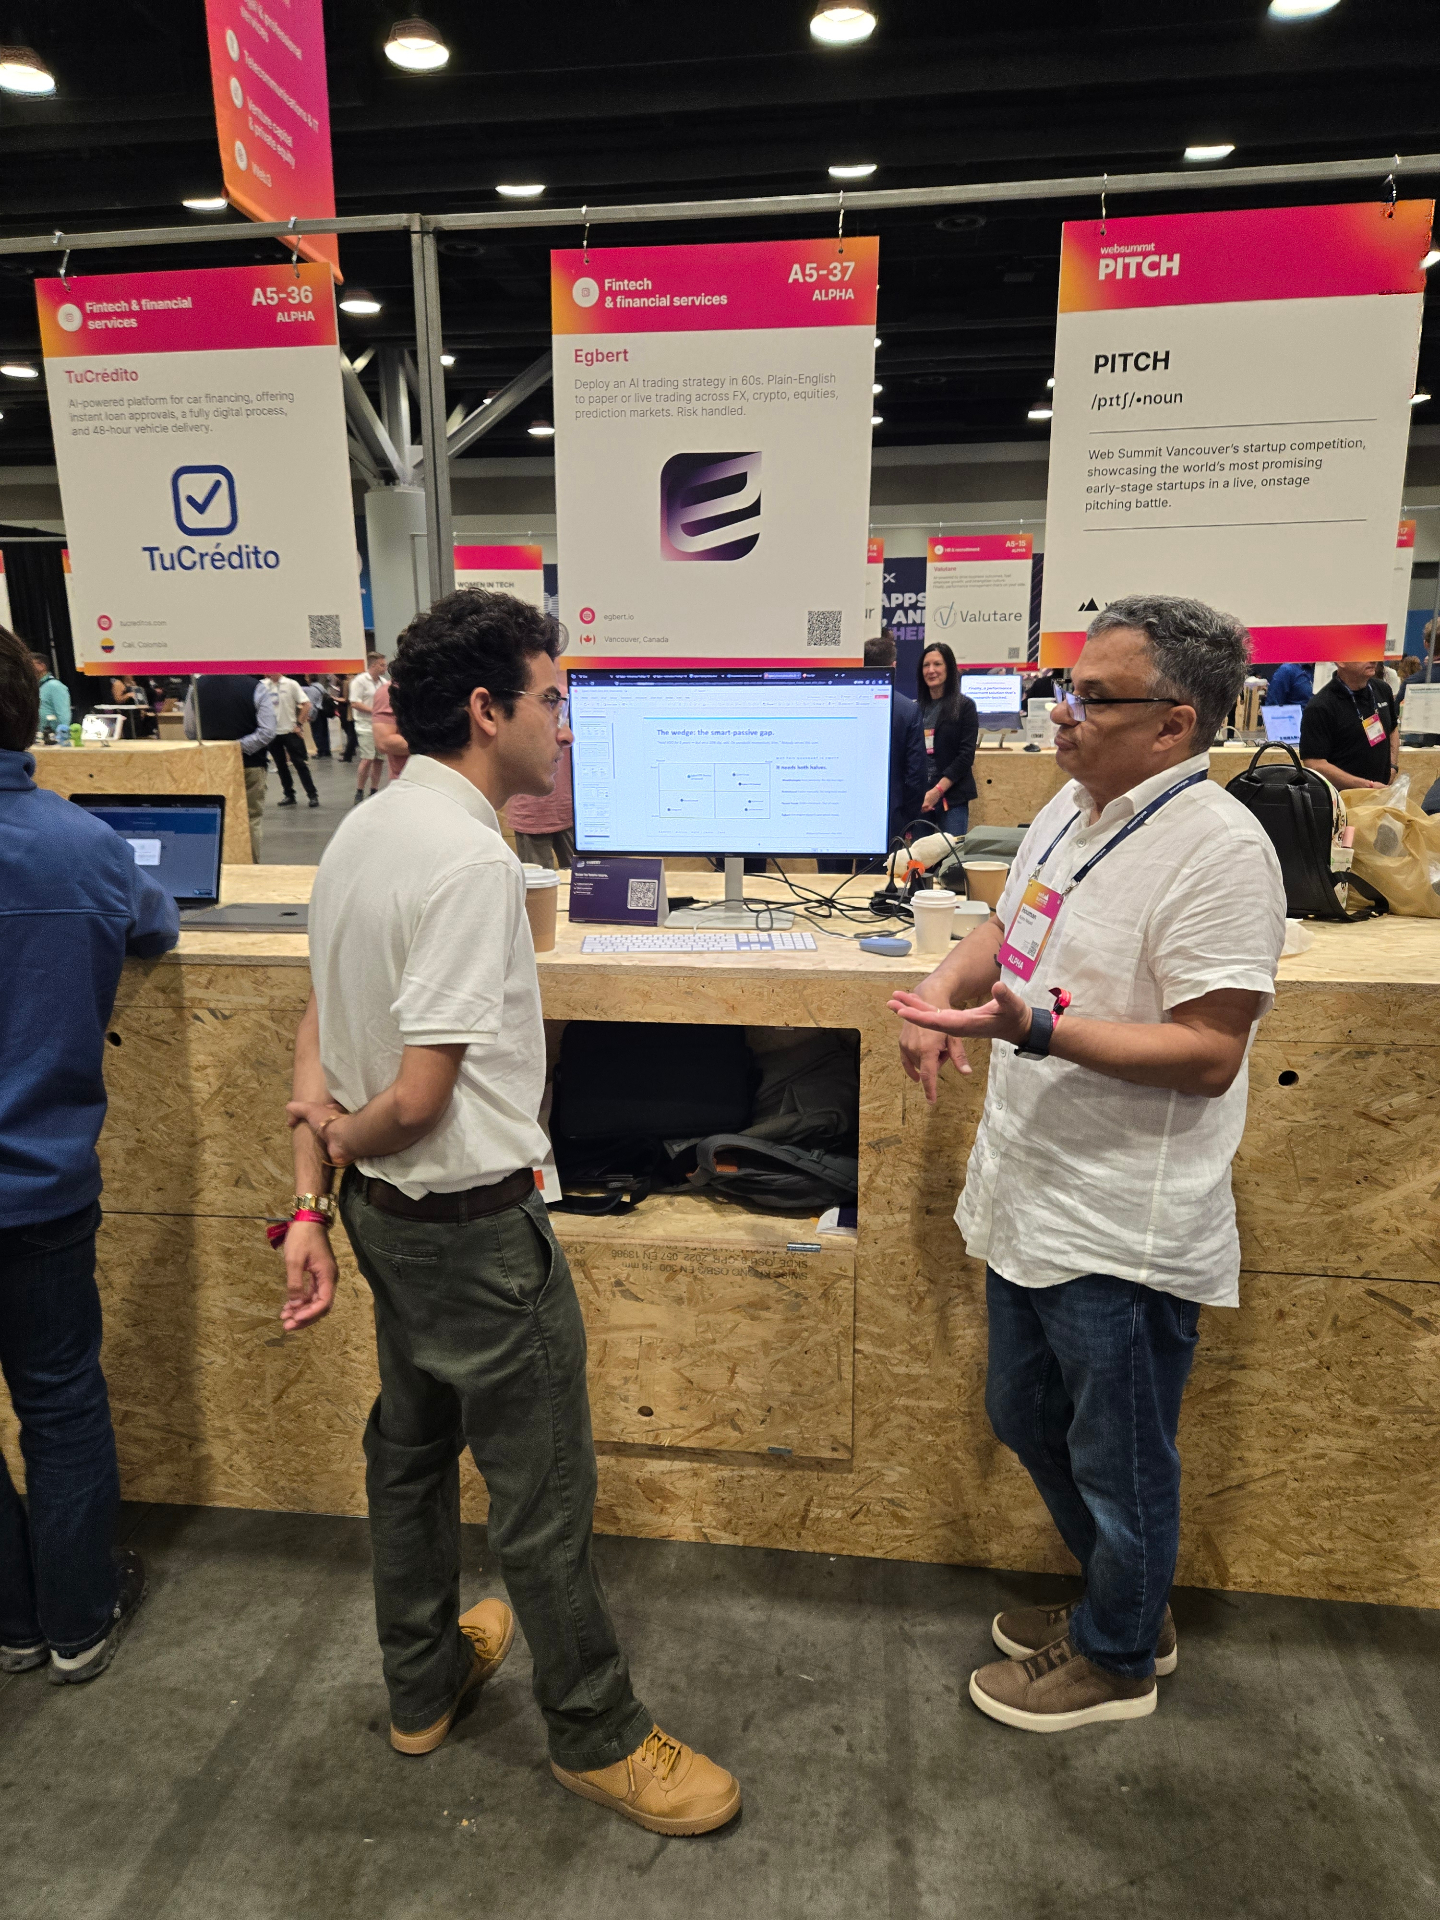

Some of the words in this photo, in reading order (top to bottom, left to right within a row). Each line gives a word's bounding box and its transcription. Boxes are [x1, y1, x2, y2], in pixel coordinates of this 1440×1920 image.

[1100, 242, 1155, 254] websummit
[788, 262, 855, 283] A5-37
[1099, 253, 1180, 280] PITCH
[604, 278, 652, 291] Fintech
[252, 286, 313, 306] A5-36
[605, 296, 614, 308] &
[616, 294, 670, 308] financial
[673, 293, 728, 306] services
[812, 289, 855, 301] ALPHA
[86, 300, 129, 314] Fintech
[131, 300, 140, 311] &
[142, 297, 192, 310] financial
[88, 317, 138, 330] services
[276, 311, 315, 323] ALPHA
[574, 349, 629, 367] Egbert
[1094, 350, 1170, 374] PITCH
[65, 368, 139, 384] TuCrédito
[574, 378, 610, 391] Deploy
[613, 380, 626, 389] an
[629, 378, 639, 388] AI
[642, 377, 679, 389] trading
[682, 376, 726, 389] strategy
[729, 376, 738, 386] in
[741, 375, 764, 386] 60s.
[767, 373, 836, 387] Plain-English
[69, 397, 124, 410] AI-powered
[127, 396, 168, 409] platform
[170, 395, 184, 405] for
[187, 396, 202, 405] car
[204, 392, 253, 405] financing,
[256, 391, 294, 403] offering
[575, 395, 585, 404] to
[588, 394, 618, 406] paper
[621, 395, 631, 404] or
[634, 392, 652, 403] live
[655, 392, 692, 405] trading
[695, 392, 730, 402] across
[733, 390, 749, 403] FX,
[752, 390, 790, 403] crypto,
[793, 388, 839, 401] equities,
[70, 411, 102, 422] instant
[105, 410, 126, 421] loan
[128, 408, 178, 421] approvals,
[181, 411, 187, 419] a
[189, 407, 210, 420] fully
[213, 406, 243, 419] digital
[245, 405, 288, 418] process,
[575, 407, 627, 420] prediction
[629, 407, 674, 418] markets.
[677, 406, 698, 417] Risk
[701, 405, 746, 417] handled.
[72, 425, 90, 436] and
[93, 424, 132, 435] 48-hour
[135, 423, 168, 434] vehicle
[171, 421, 213, 434] delivery.
[1088, 449, 1114, 460] Web
[1118, 446, 1162, 459] Summit
[1243, 442, 1286, 454] startup
[1290, 438, 1366, 452] competition,
[1087, 464, 1157, 477] showcasing
[1160, 463, 1179, 474] the
[1228, 460, 1259, 471] most
[1262, 457, 1323, 471] promising
[1086, 482, 1153, 495] early-stage
[1156, 480, 1205, 492] startups
[1208, 478, 1219, 489] in
[1222, 480, 1230, 488] a
[1233, 477, 1257, 489] live,
[1261, 476, 1310, 488] onstage
[1085, 499, 1132, 512] pitching
[1135, 498, 1172, 509] battle.
[1005, 540, 1026, 548] A5-15
[142, 543, 280, 571] TuCrédito
[960, 610, 1022, 623] Valutare
[604, 636, 641, 644] Vancouver,
[671, 729, 696, 737] wedge:
[760, 729, 775, 737] gap.
